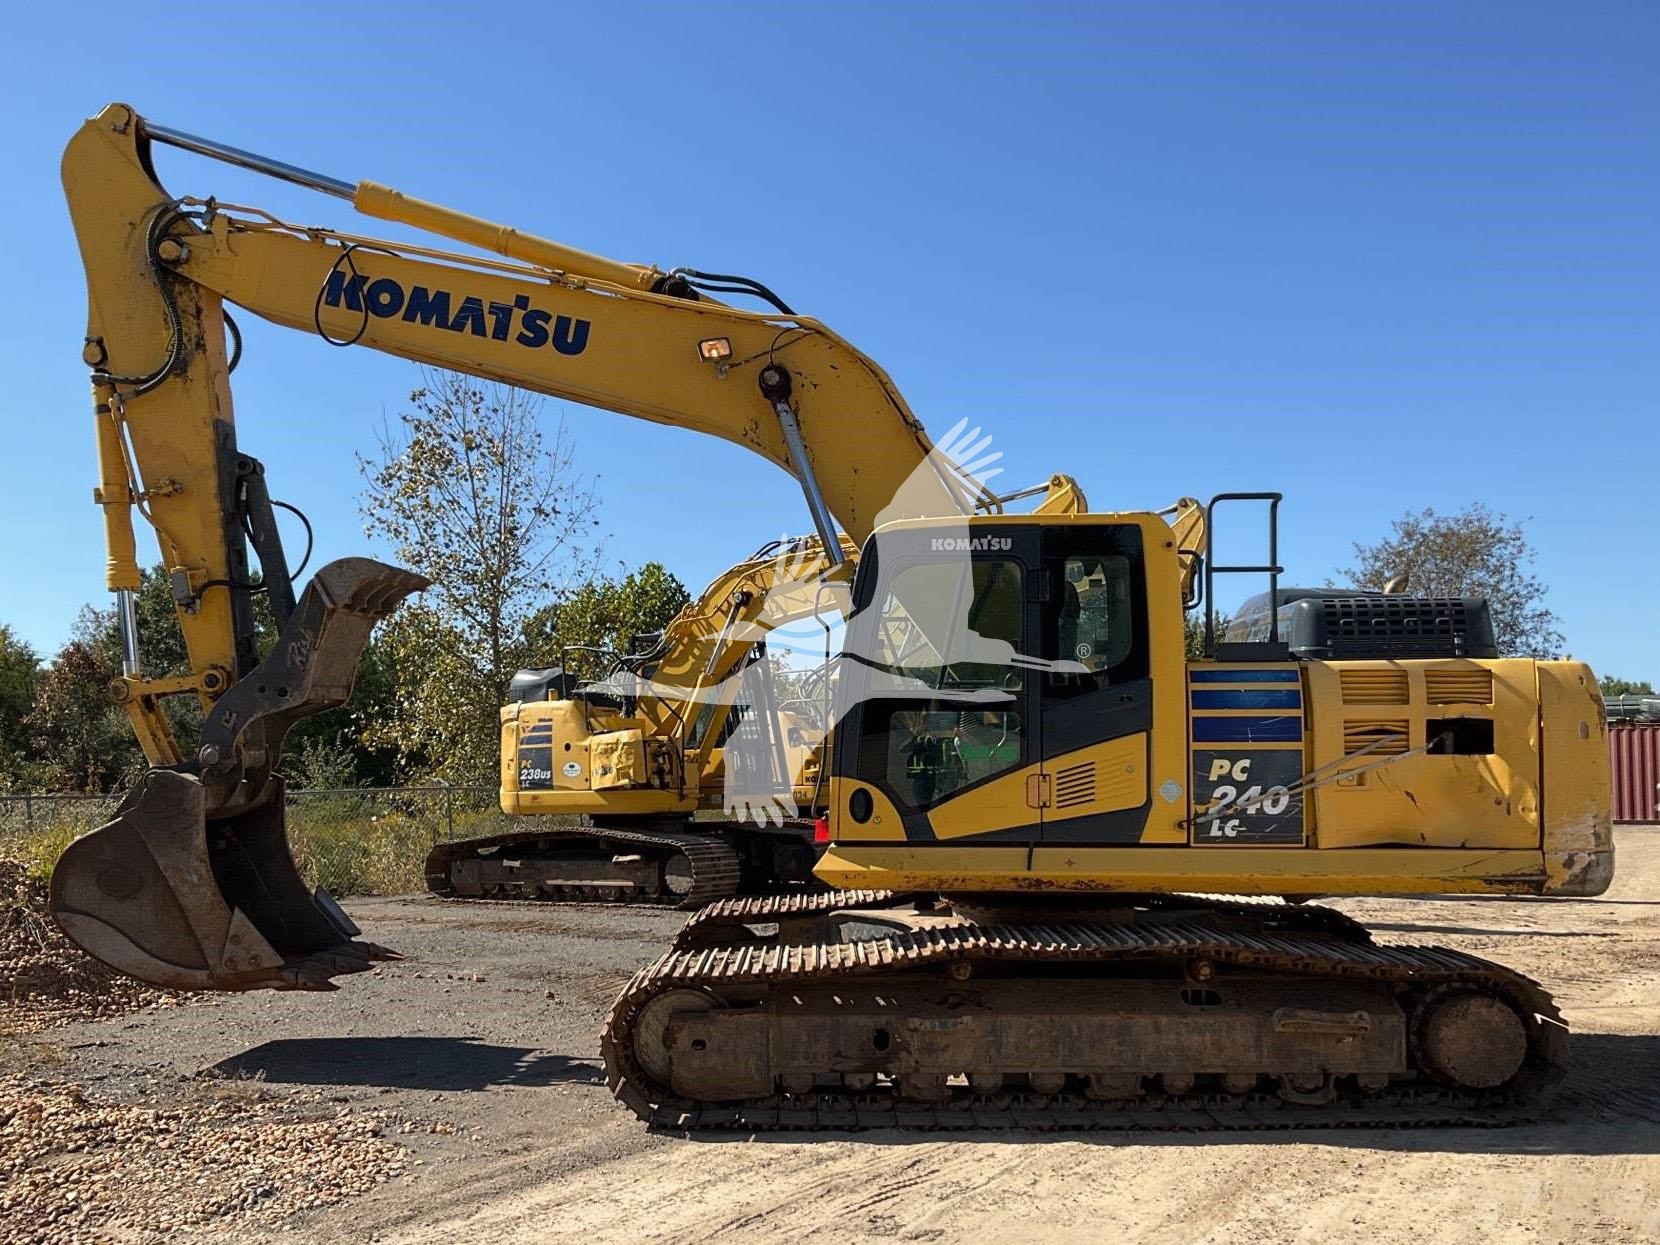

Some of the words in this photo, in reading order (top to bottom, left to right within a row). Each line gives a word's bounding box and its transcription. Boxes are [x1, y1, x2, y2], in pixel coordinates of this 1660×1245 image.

[324, 270, 591, 356] KOMATSU
[931, 535, 1012, 551] KOMATSU
[1209, 758, 1251, 781] PC
[1208, 785, 1290, 815] 240
[1209, 819, 1240, 837] LC
